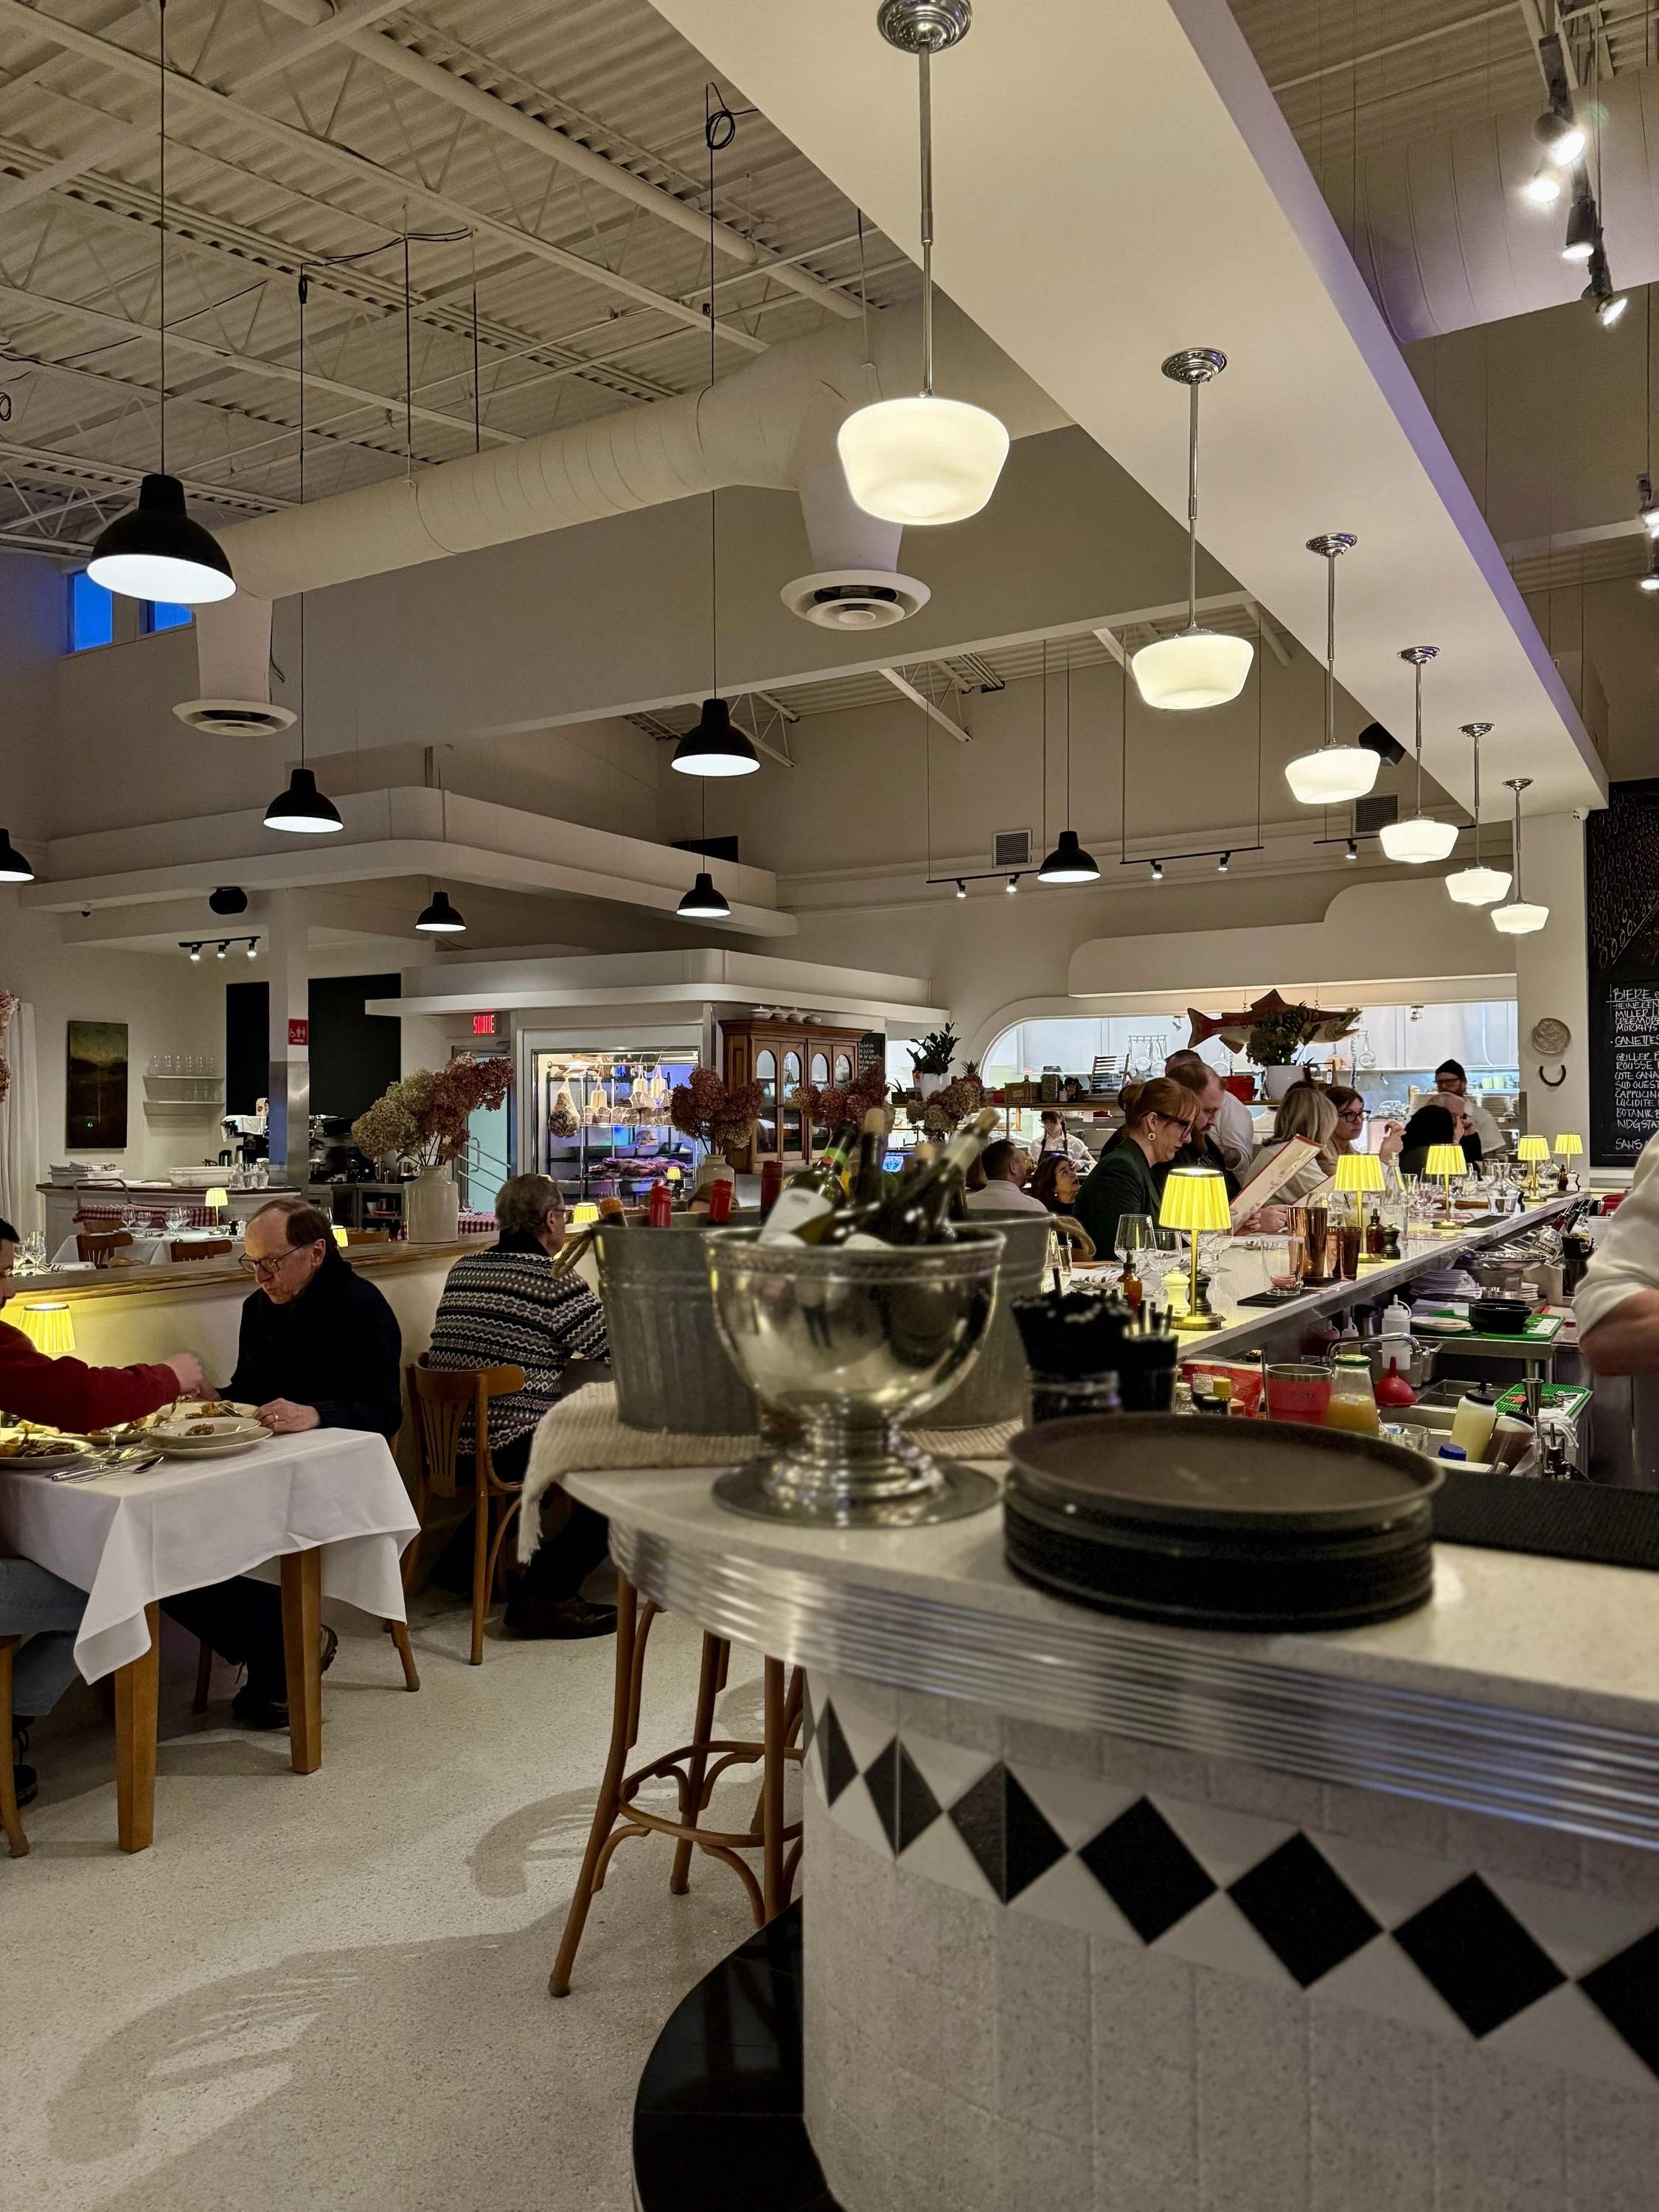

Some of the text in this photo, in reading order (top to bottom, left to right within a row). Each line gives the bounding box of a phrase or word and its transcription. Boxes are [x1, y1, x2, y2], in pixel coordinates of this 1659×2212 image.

[1613, 988, 1652, 1001] BIERE
[1615, 1009, 1649, 1018] MILLER
[473, 1015, 495, 1034] SORTIE
[1615, 1060, 1653, 1070] ROUSSE
[1615, 1071, 1634, 1079] COTE
[1615, 1080, 1630, 1090] SUD
[1615, 1090, 1659, 1099] CAPPUCIN
[1616, 1107, 1652, 1119] BOTANIK
[1615, 1138, 1642, 1150] SANS
